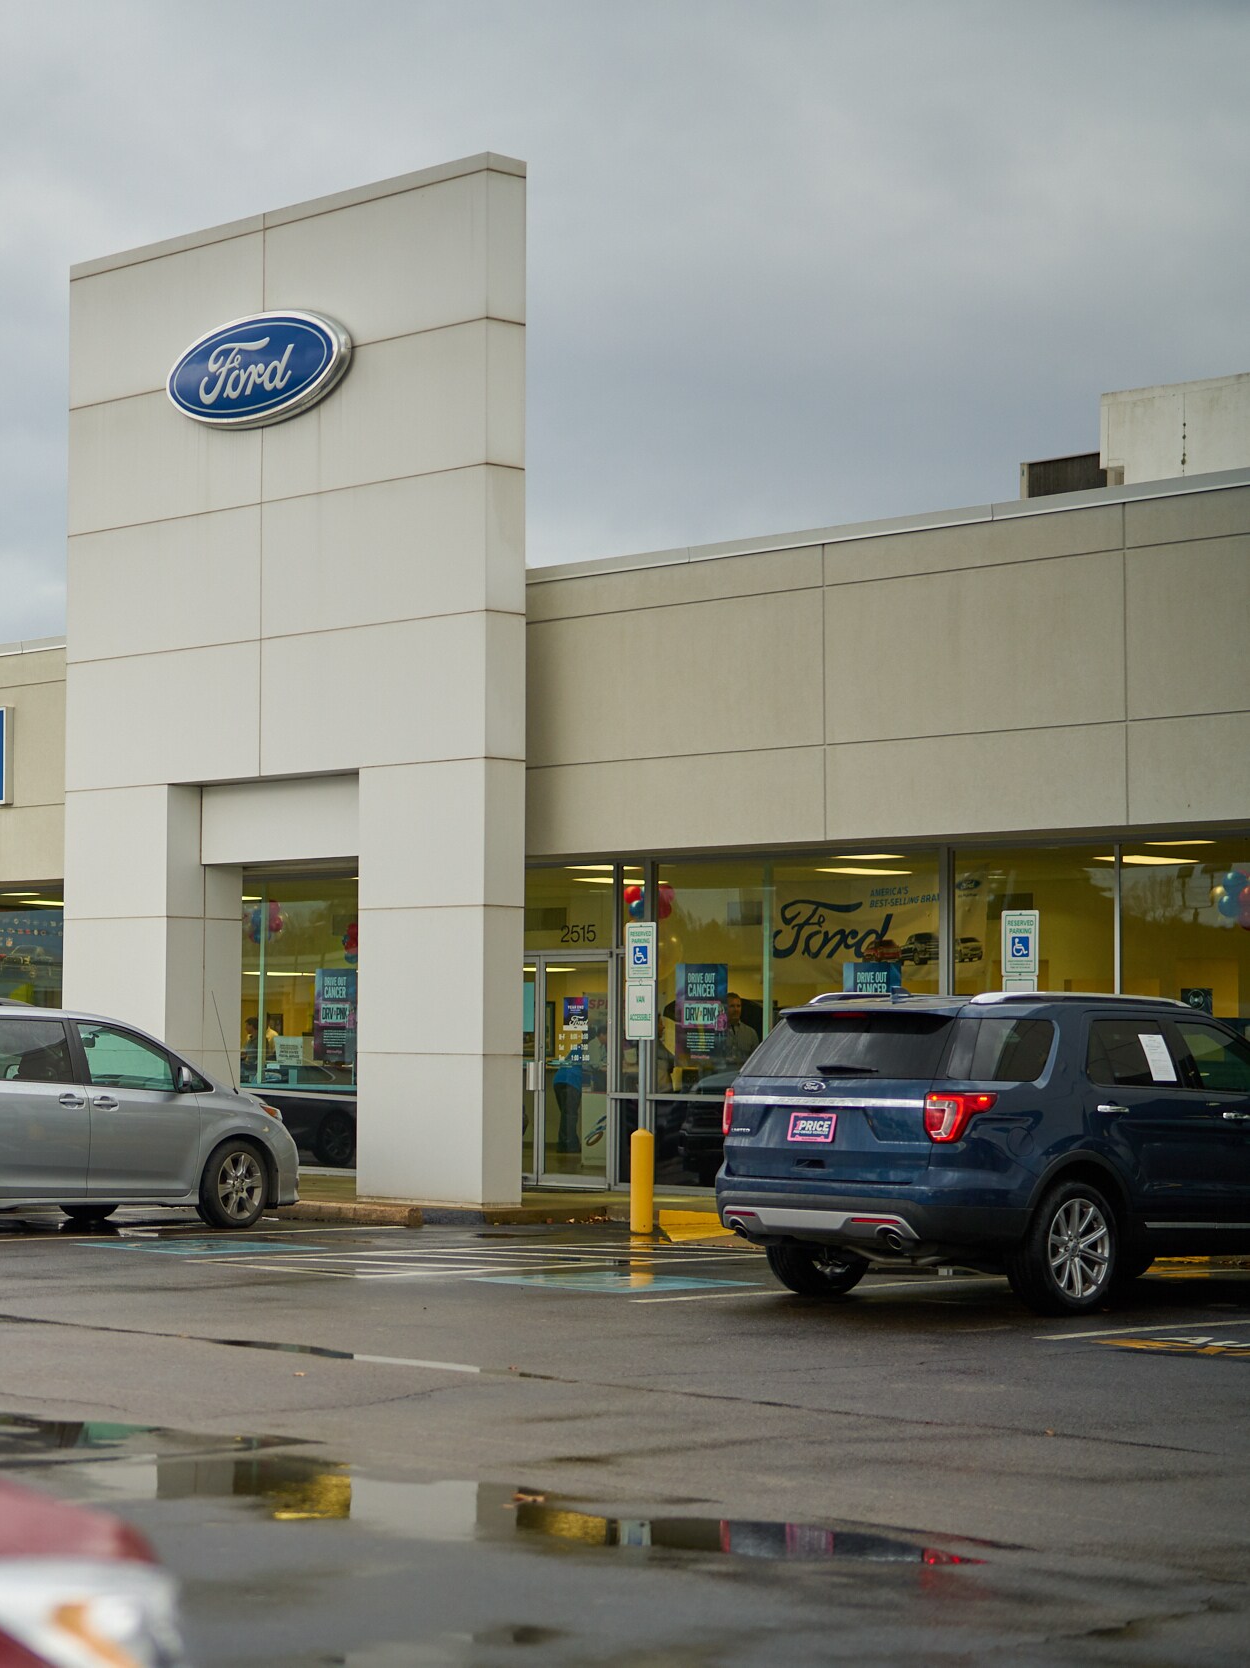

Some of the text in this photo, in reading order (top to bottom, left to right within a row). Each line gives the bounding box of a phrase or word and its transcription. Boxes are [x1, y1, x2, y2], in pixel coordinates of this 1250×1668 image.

[199, 336, 295, 405] Ford
[870, 886, 909, 897] AMERICA'S
[869, 896, 919, 908] BEST-SELLING
[1007, 919, 1034, 927] RESERVED
[560, 924, 597, 943] 2515
[772, 899, 894, 959] Ford
[324, 976, 347, 986] DRIVE OUT
[687, 972, 716, 983] DRIVE OUT
[856, 972, 887, 983] DRIVE OUT
[324, 986, 347, 999] CANCER
[687, 983, 715, 997] CANCER
[856, 983, 887, 993] CANCER
[636, 995, 645, 1003] VAN
[322, 1007, 334, 1020] DRV
[685, 1006, 717, 1021] DRV PNK
[569, 1015, 588, 1026] Ford
